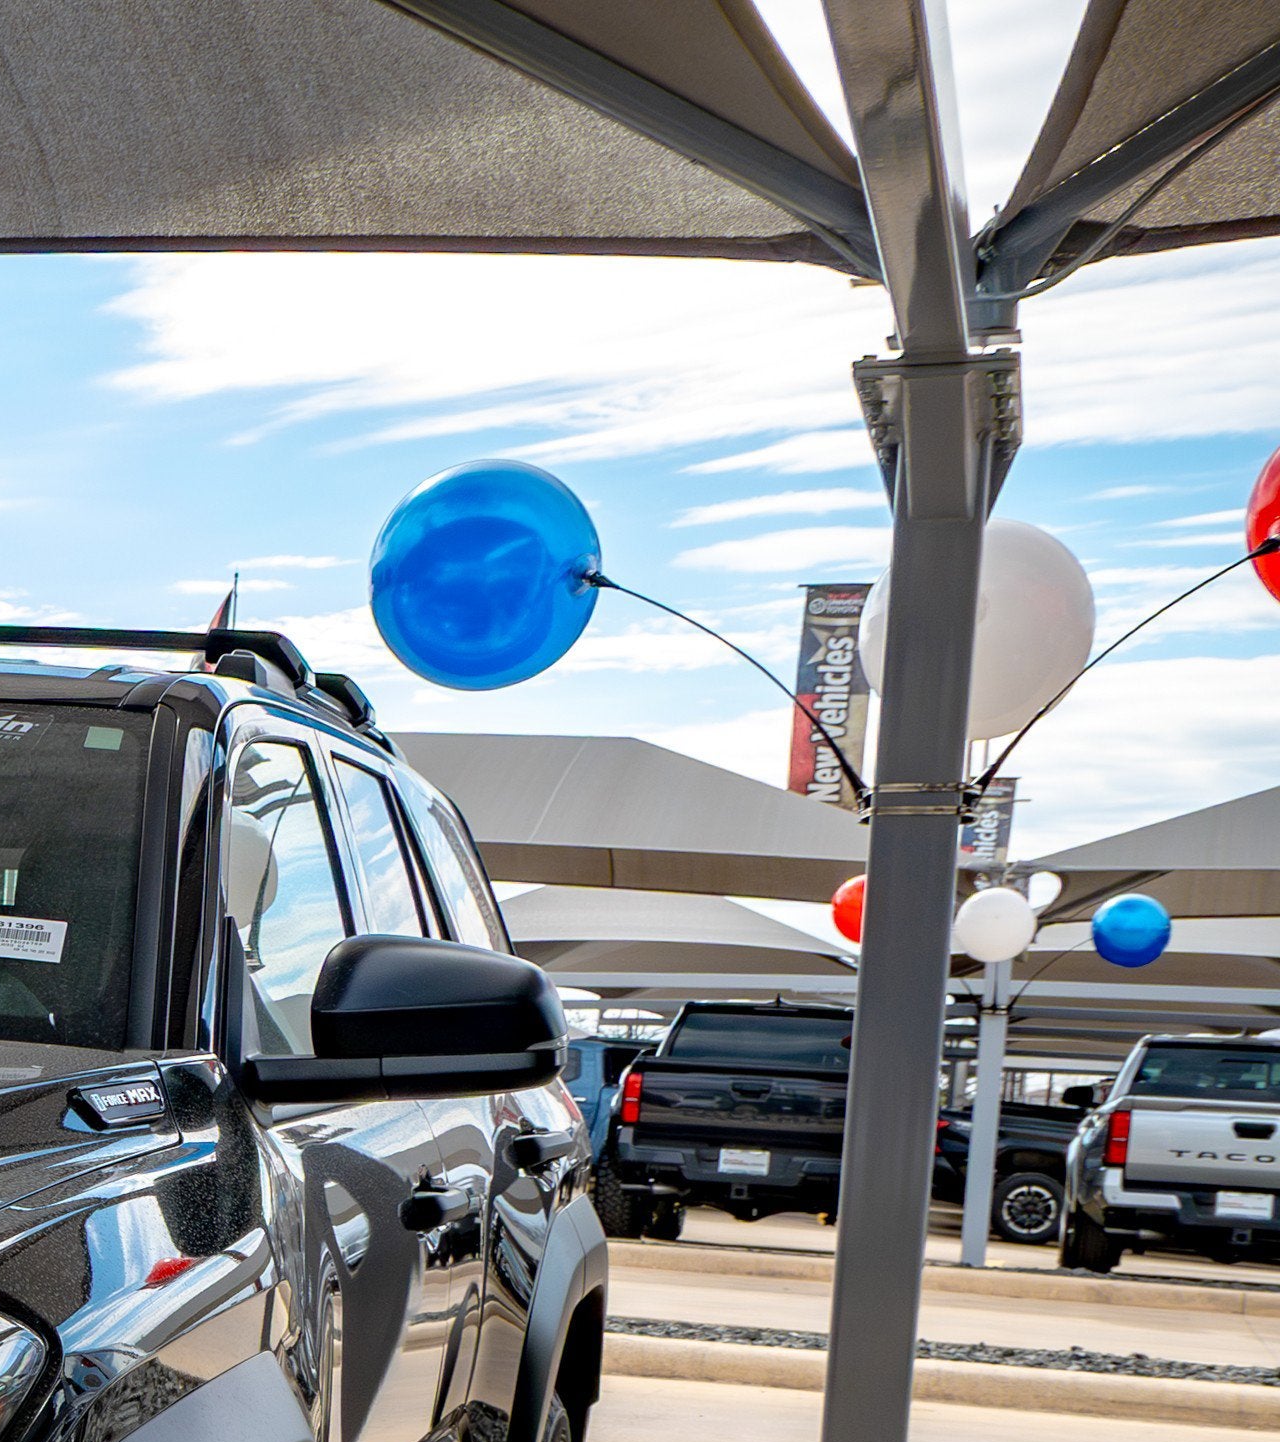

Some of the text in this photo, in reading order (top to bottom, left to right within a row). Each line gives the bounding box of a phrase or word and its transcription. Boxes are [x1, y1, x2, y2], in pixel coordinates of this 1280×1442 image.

[810, 635, 855, 742] Vehicles
[807, 746, 841, 802] New
[971, 809, 999, 858] hicles
[126, 1086, 161, 1104] MAX
